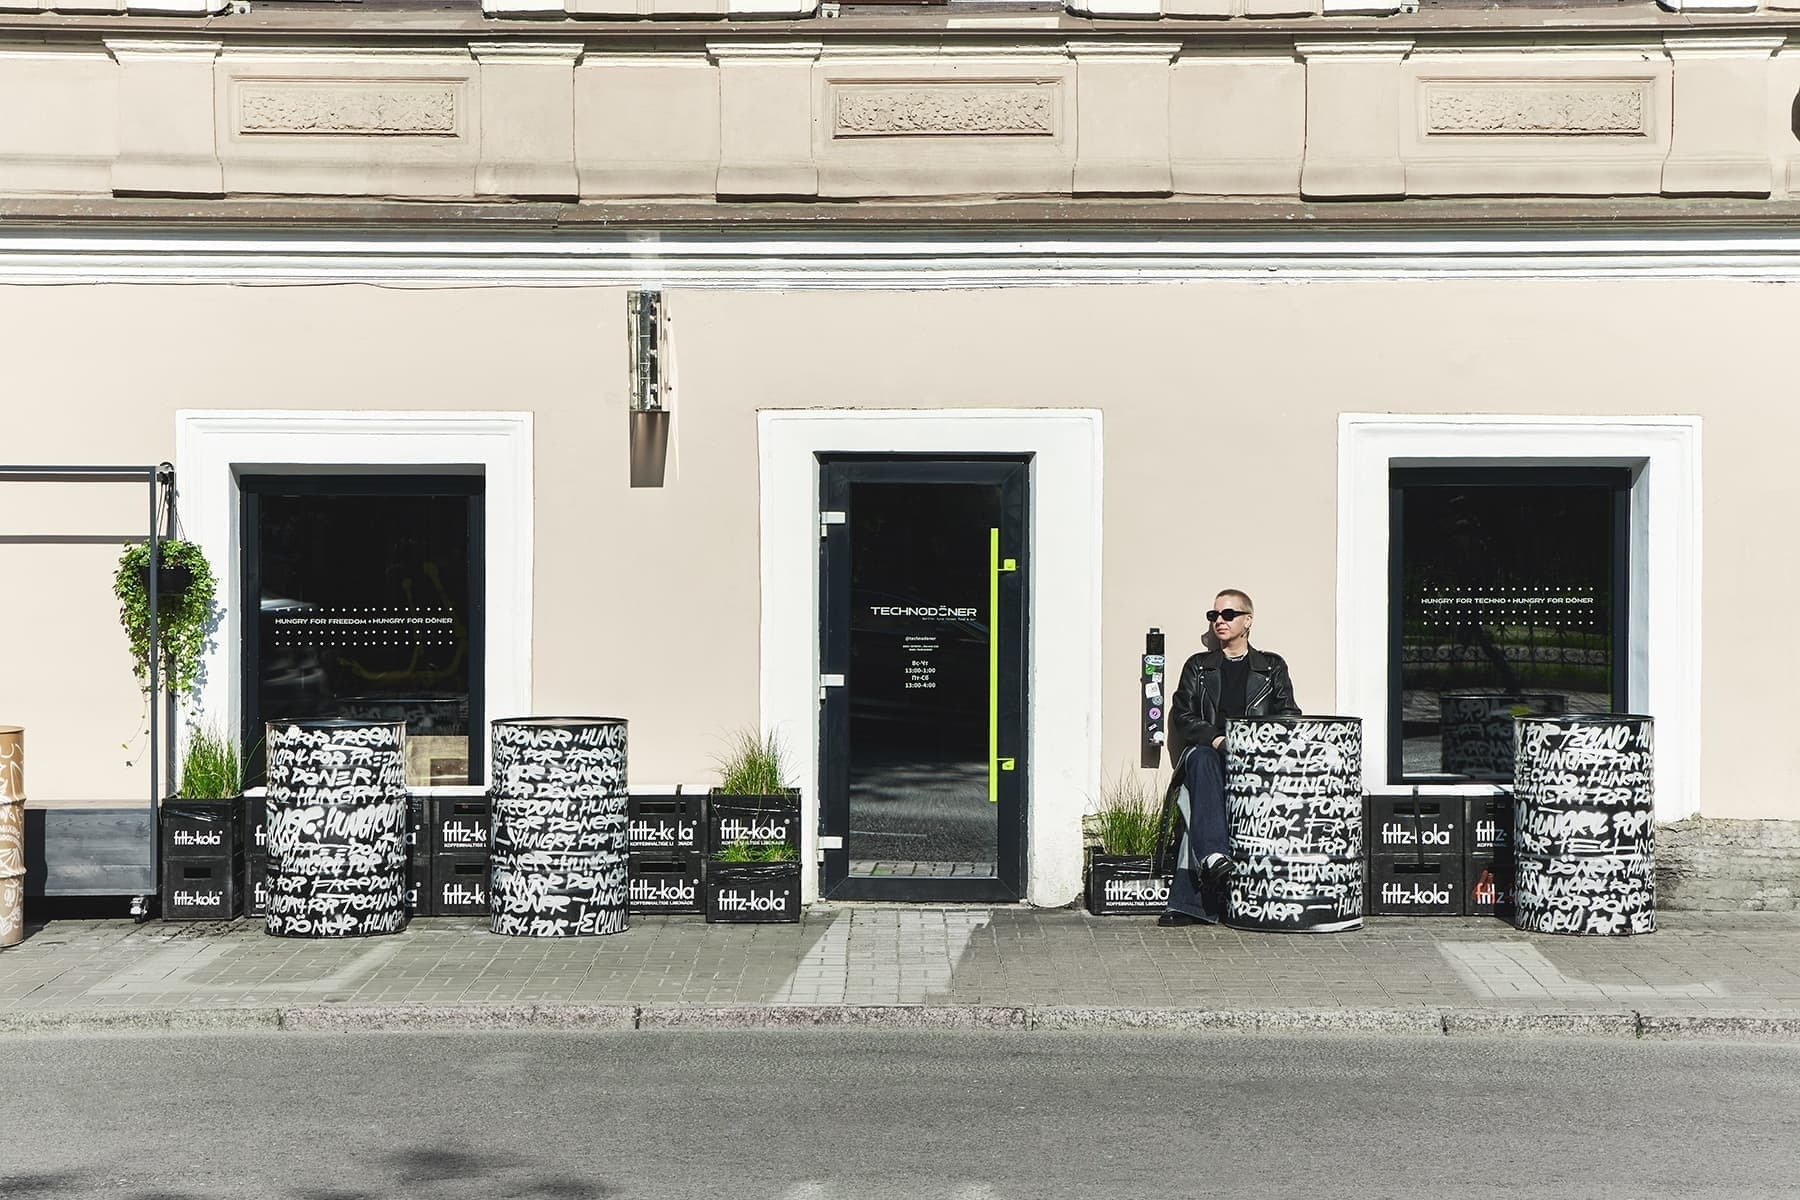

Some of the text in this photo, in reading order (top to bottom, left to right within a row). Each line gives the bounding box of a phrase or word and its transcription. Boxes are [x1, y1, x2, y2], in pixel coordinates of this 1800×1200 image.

[291, 766, 372, 787] DÖNER
[174, 830, 223, 846] fritz-kola
[442, 820, 487, 842] fritz-k
[720, 818, 788, 840] fritz-kola
[174, 890, 223, 906] fritz-kola
[442, 883, 486, 905] fritz-k
[628, 878, 697, 901] fritz-kola
[718, 889, 787, 911] fritz-kola
[1104, 879, 1171, 901] fritz-kola
[1381, 883, 1451, 905] fritz-kola
